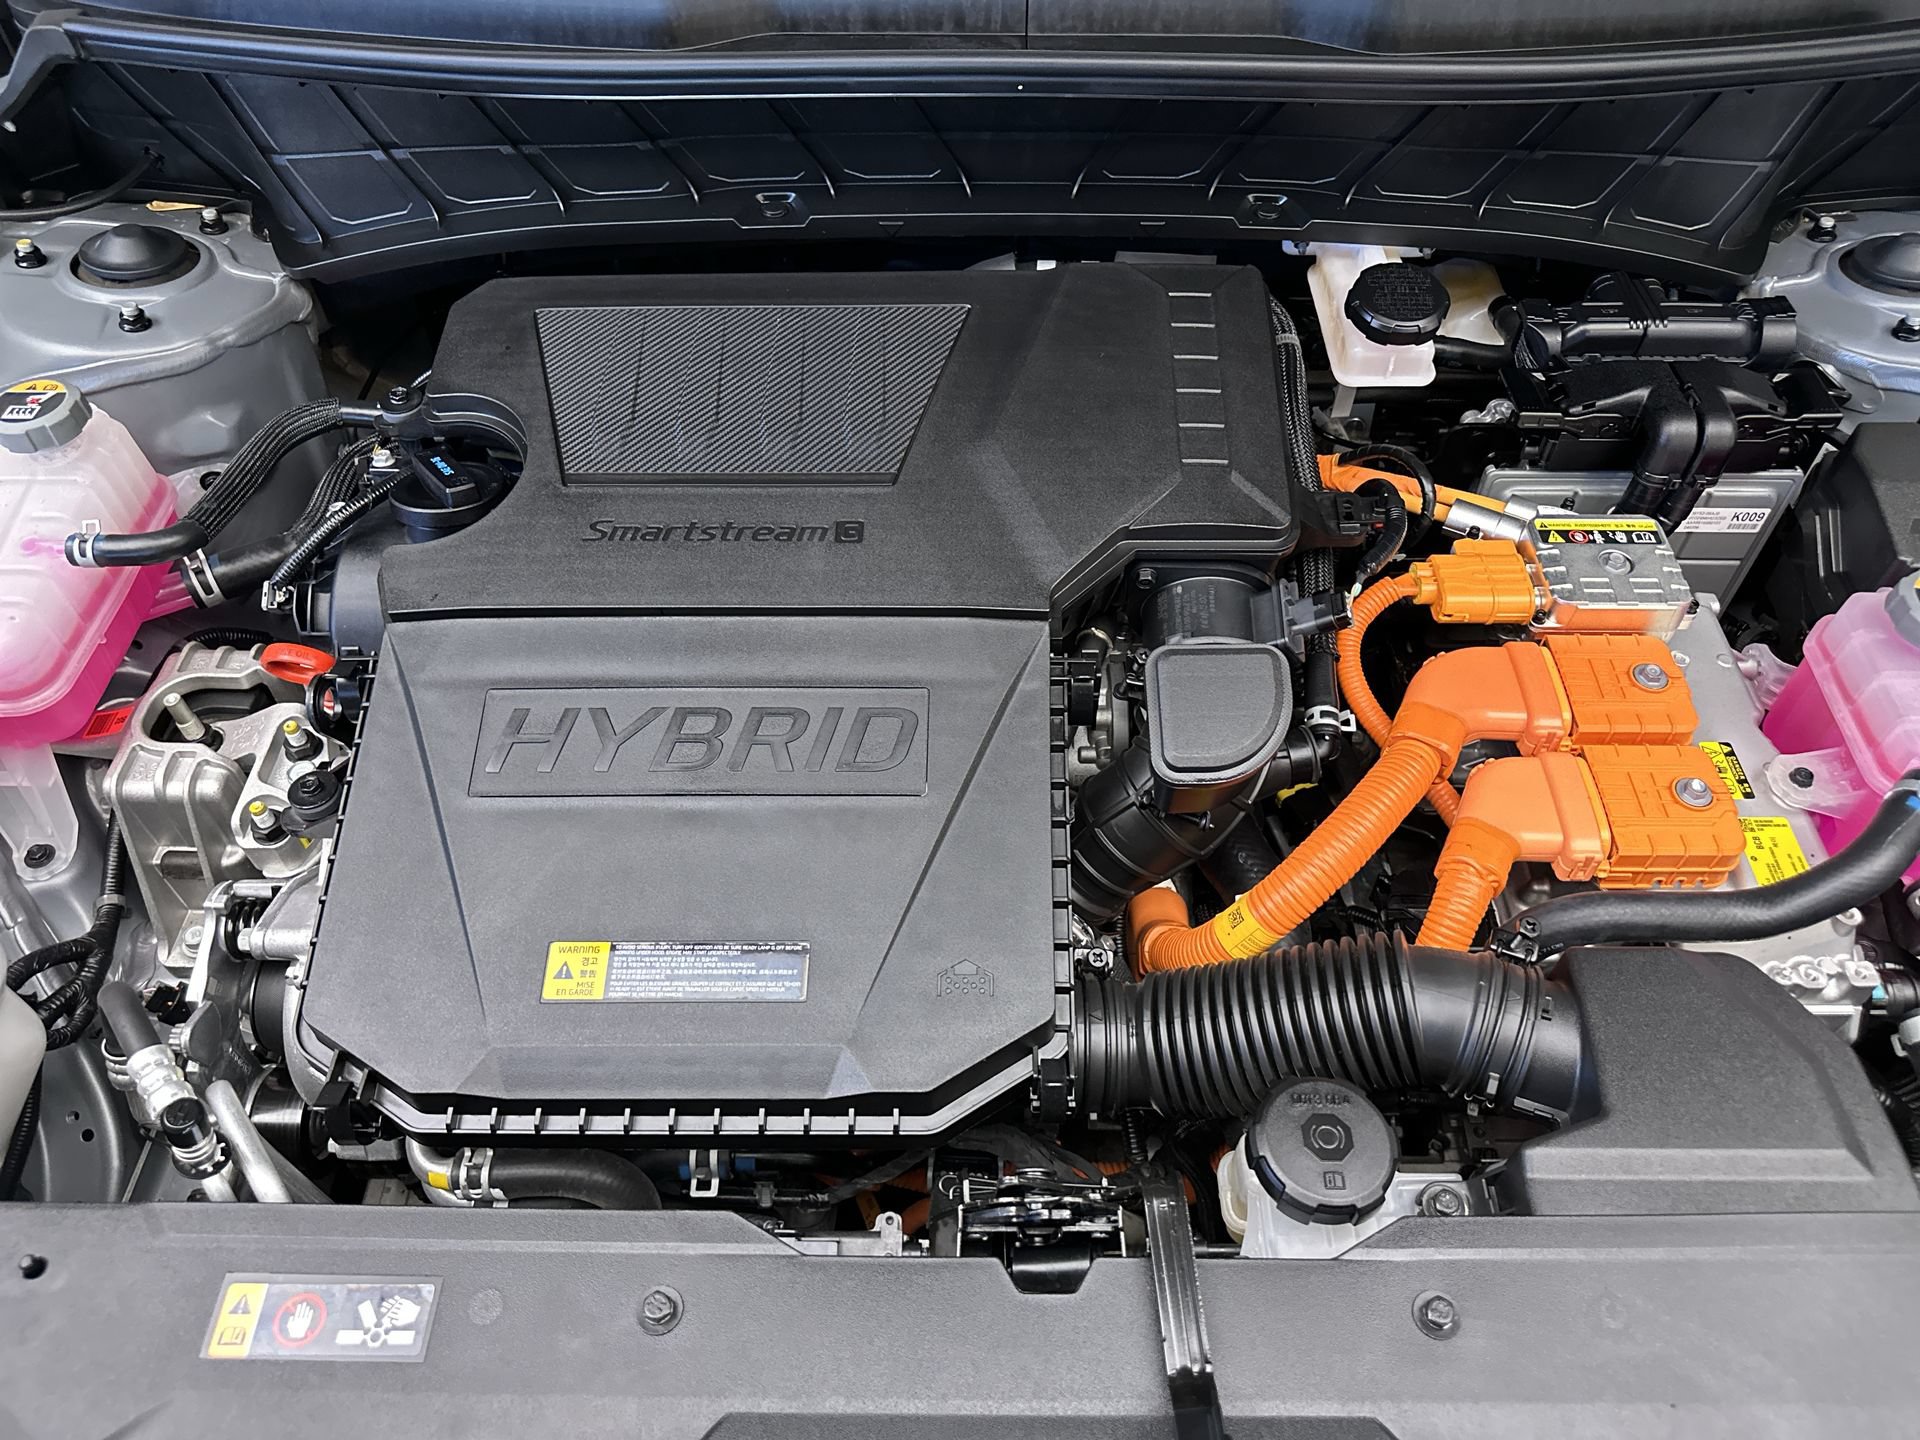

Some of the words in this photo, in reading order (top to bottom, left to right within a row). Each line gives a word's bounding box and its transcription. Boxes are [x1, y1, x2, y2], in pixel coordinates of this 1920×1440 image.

[1730, 512, 1766, 522] K009
[582, 518, 830, 542] Smartstream
[484, 706, 920, 774] HYBRID
[558, 945, 600, 954] WARNING
[582, 957, 598, 966] 경고
